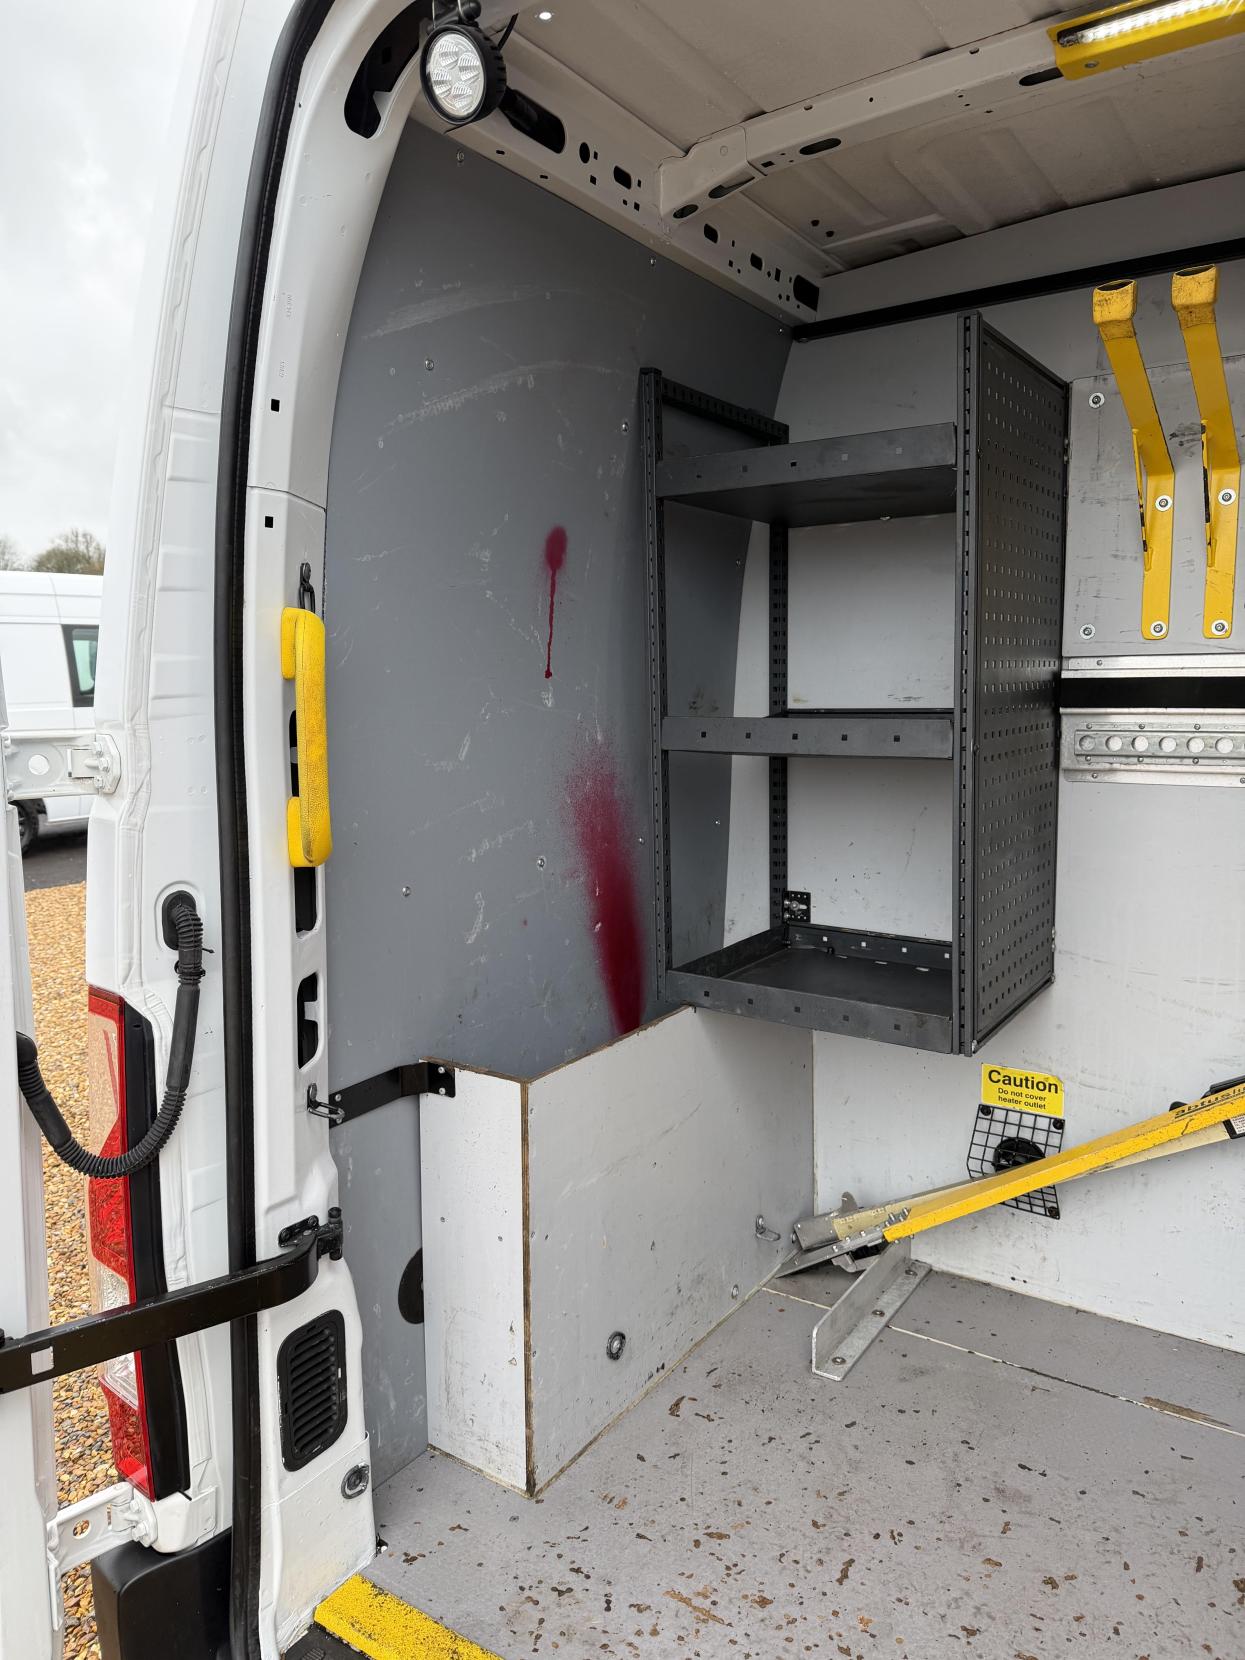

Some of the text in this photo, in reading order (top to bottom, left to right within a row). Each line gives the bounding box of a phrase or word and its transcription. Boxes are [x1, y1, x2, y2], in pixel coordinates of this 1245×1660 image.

[988, 1069, 1058, 1094] Caution
[998, 1087, 1047, 1102] Do not cover
[998, 1095, 1046, 1110] heater outlet
